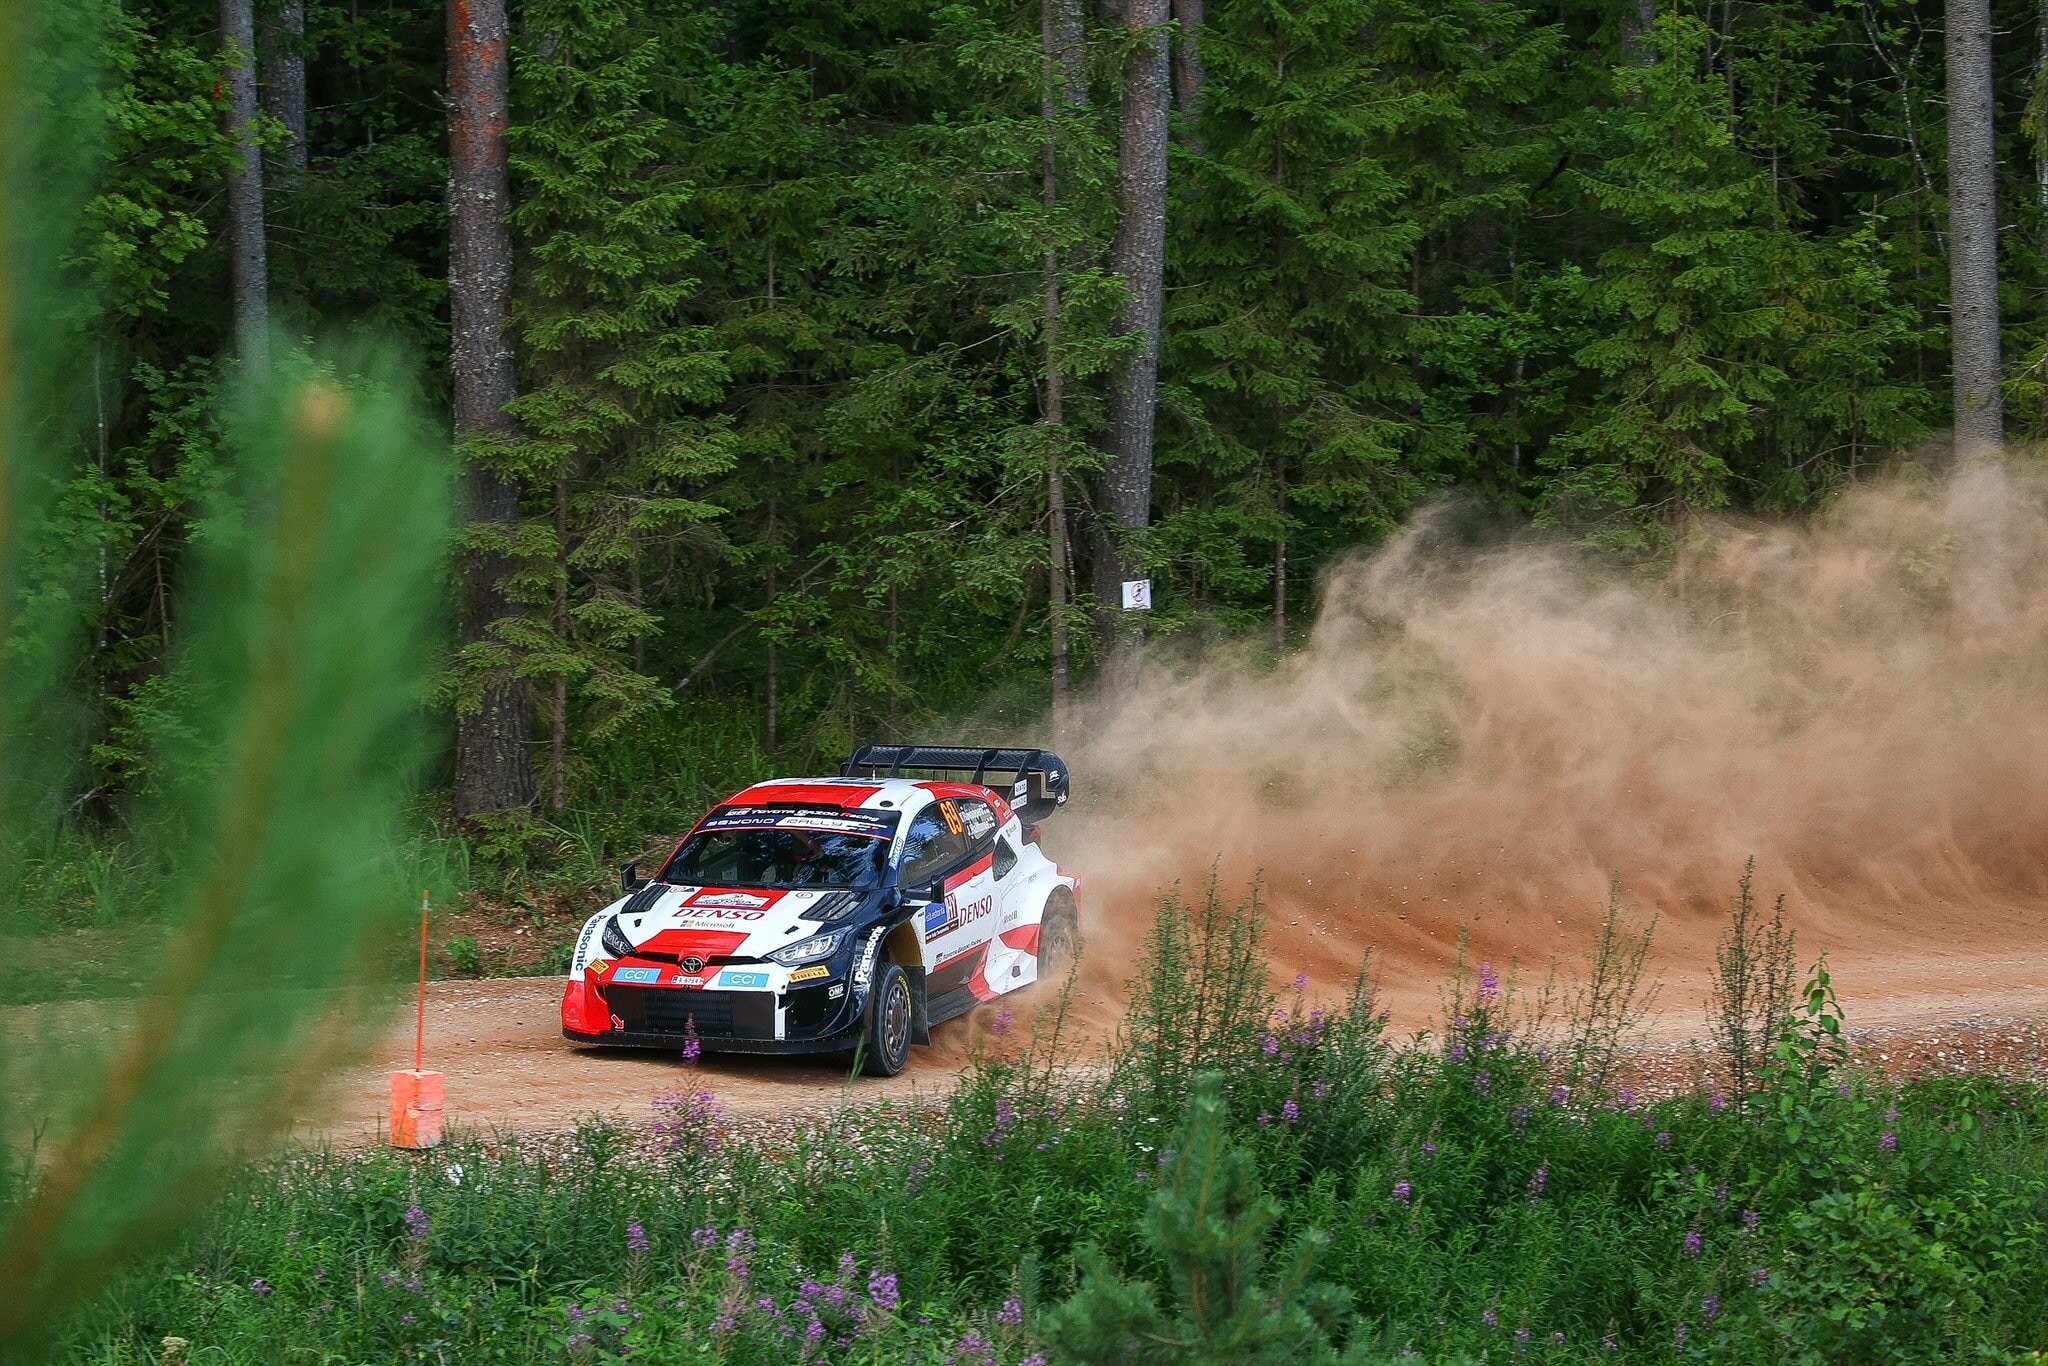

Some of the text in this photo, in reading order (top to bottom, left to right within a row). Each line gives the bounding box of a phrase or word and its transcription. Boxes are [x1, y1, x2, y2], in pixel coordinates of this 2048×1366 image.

[706, 817, 844, 827] BEYOND RALLY
[840, 812, 881, 822] Racing
[940, 800, 963, 835] 69
[671, 908, 766, 921] DENSO
[959, 894, 994, 928] DENSO
[694, 921, 736, 929] Microsoft
[574, 914, 608, 972] Panasonic
[854, 925, 887, 984] Panasonic
[624, 969, 650, 981] CCI
[730, 975, 758, 986] CCI
[789, 967, 826, 981] PIRELLI
[828, 984, 844, 998] OMP
